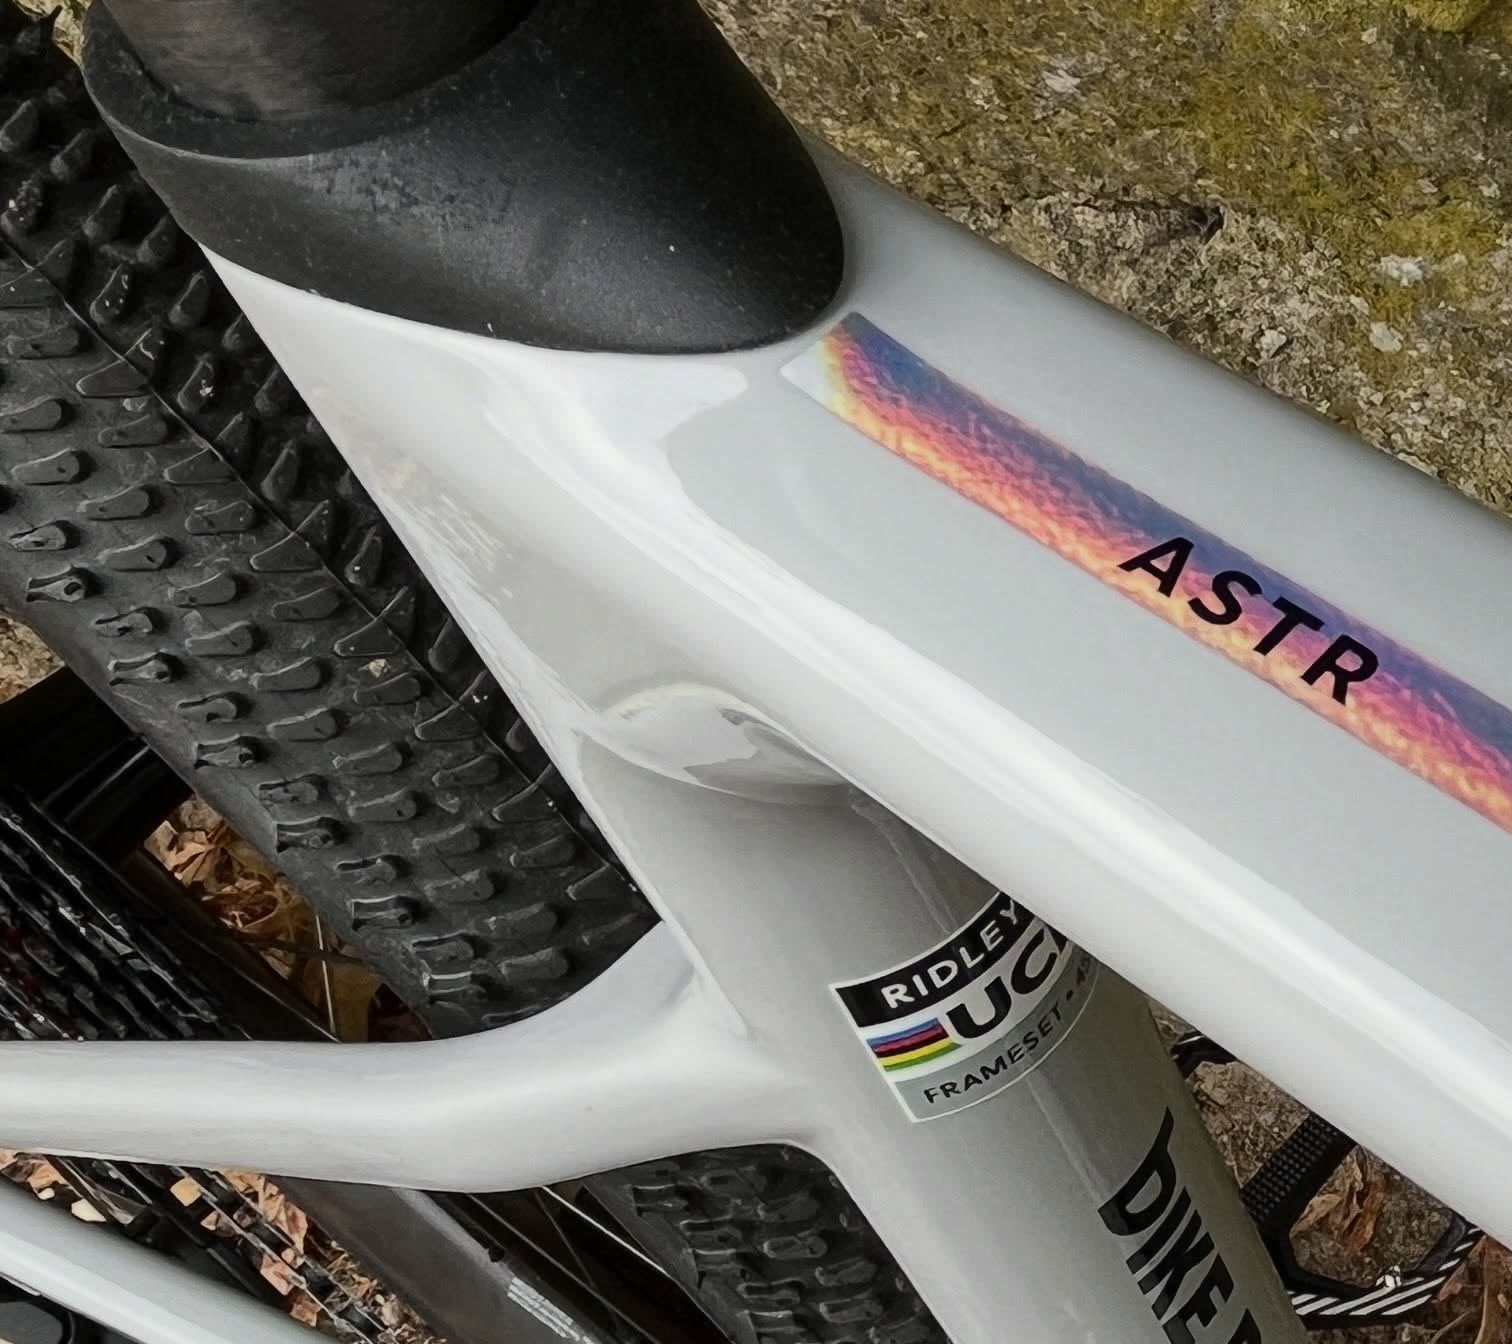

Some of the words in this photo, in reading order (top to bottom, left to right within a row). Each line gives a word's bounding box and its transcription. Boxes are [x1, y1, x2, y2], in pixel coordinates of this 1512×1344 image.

[1117, 537, 1379, 706] ASTR
[881, 899, 1018, 1009] RIDLEY
[923, 1001, 1063, 1104] FRAMESET
